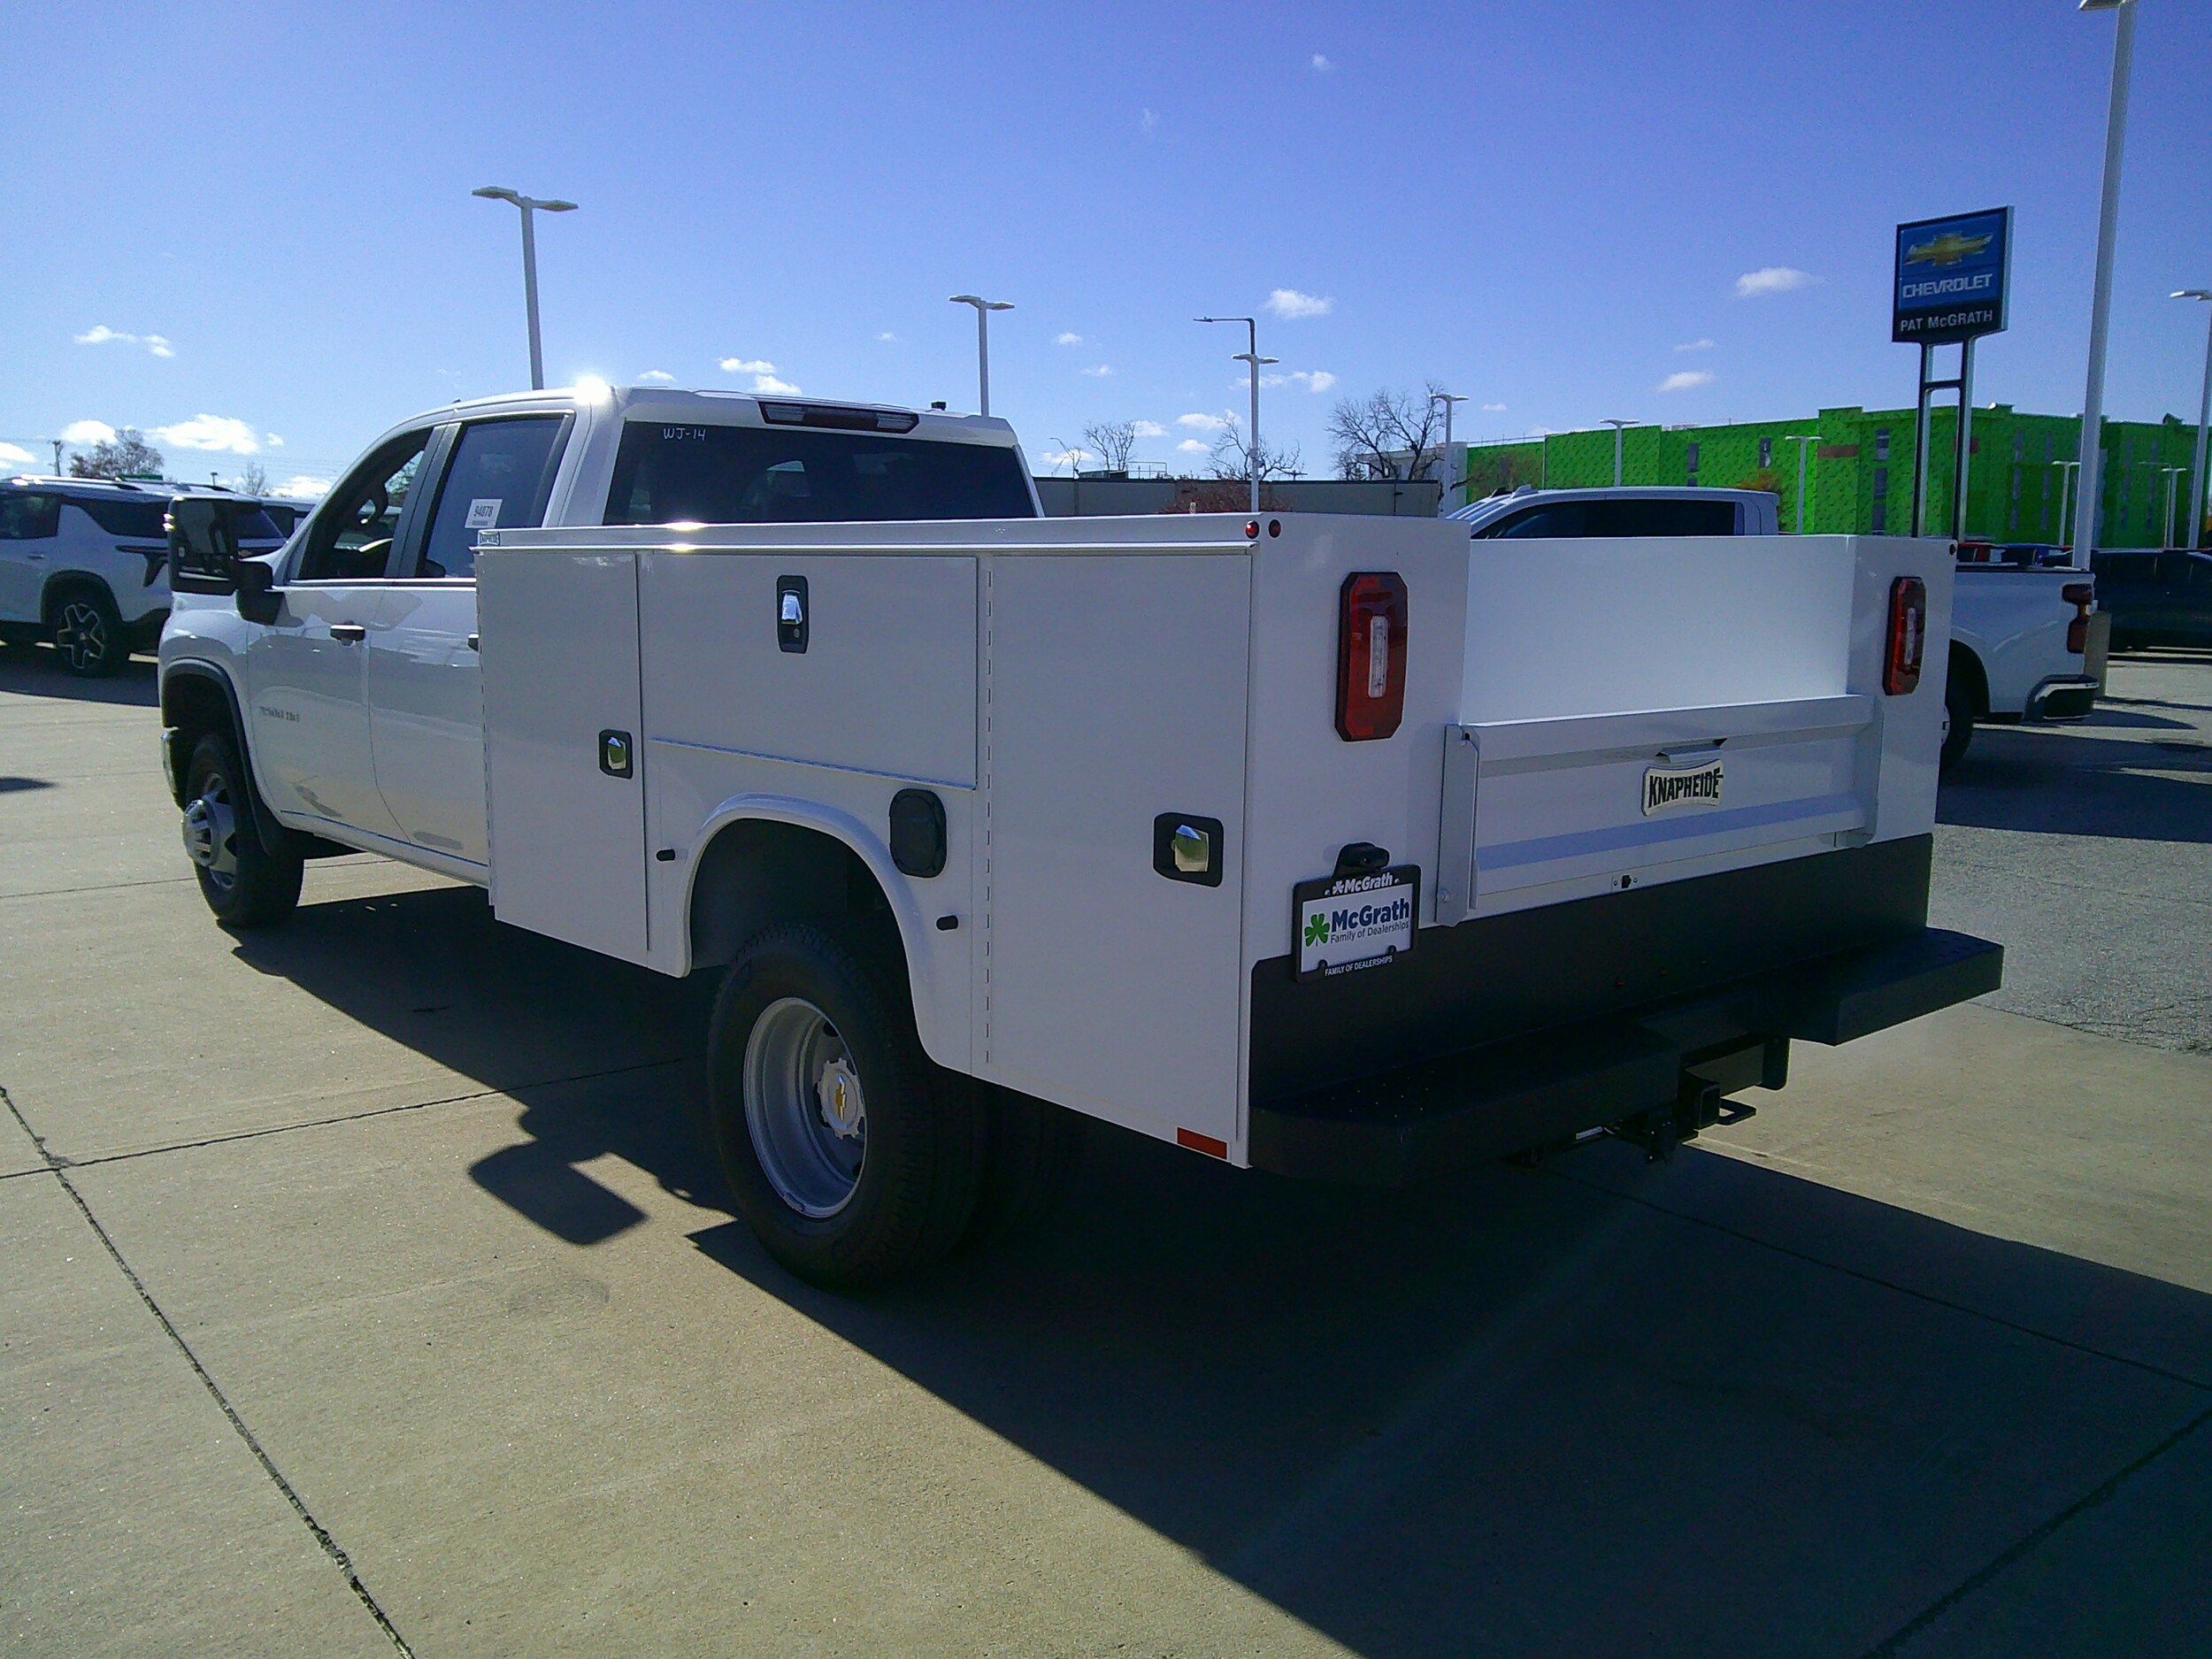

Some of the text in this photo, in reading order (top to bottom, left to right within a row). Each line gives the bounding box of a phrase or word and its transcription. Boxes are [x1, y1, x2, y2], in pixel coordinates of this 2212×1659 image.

[1903, 273, 1993, 297] CHEVROLET
[1901, 310, 1993, 332] PAT McGRATH
[663, 427, 706, 441] WJ-14
[1648, 767, 1723, 809] KNAPHEIDE
[1344, 872, 1393, 895] McGrath
[1332, 898, 1409, 932] McGrath
[1331, 932, 1356, 944] Family
[1368, 920, 1409, 936] Dealerships
[1325, 955, 1393, 977] FAMILY OF DEALERSHIPS
